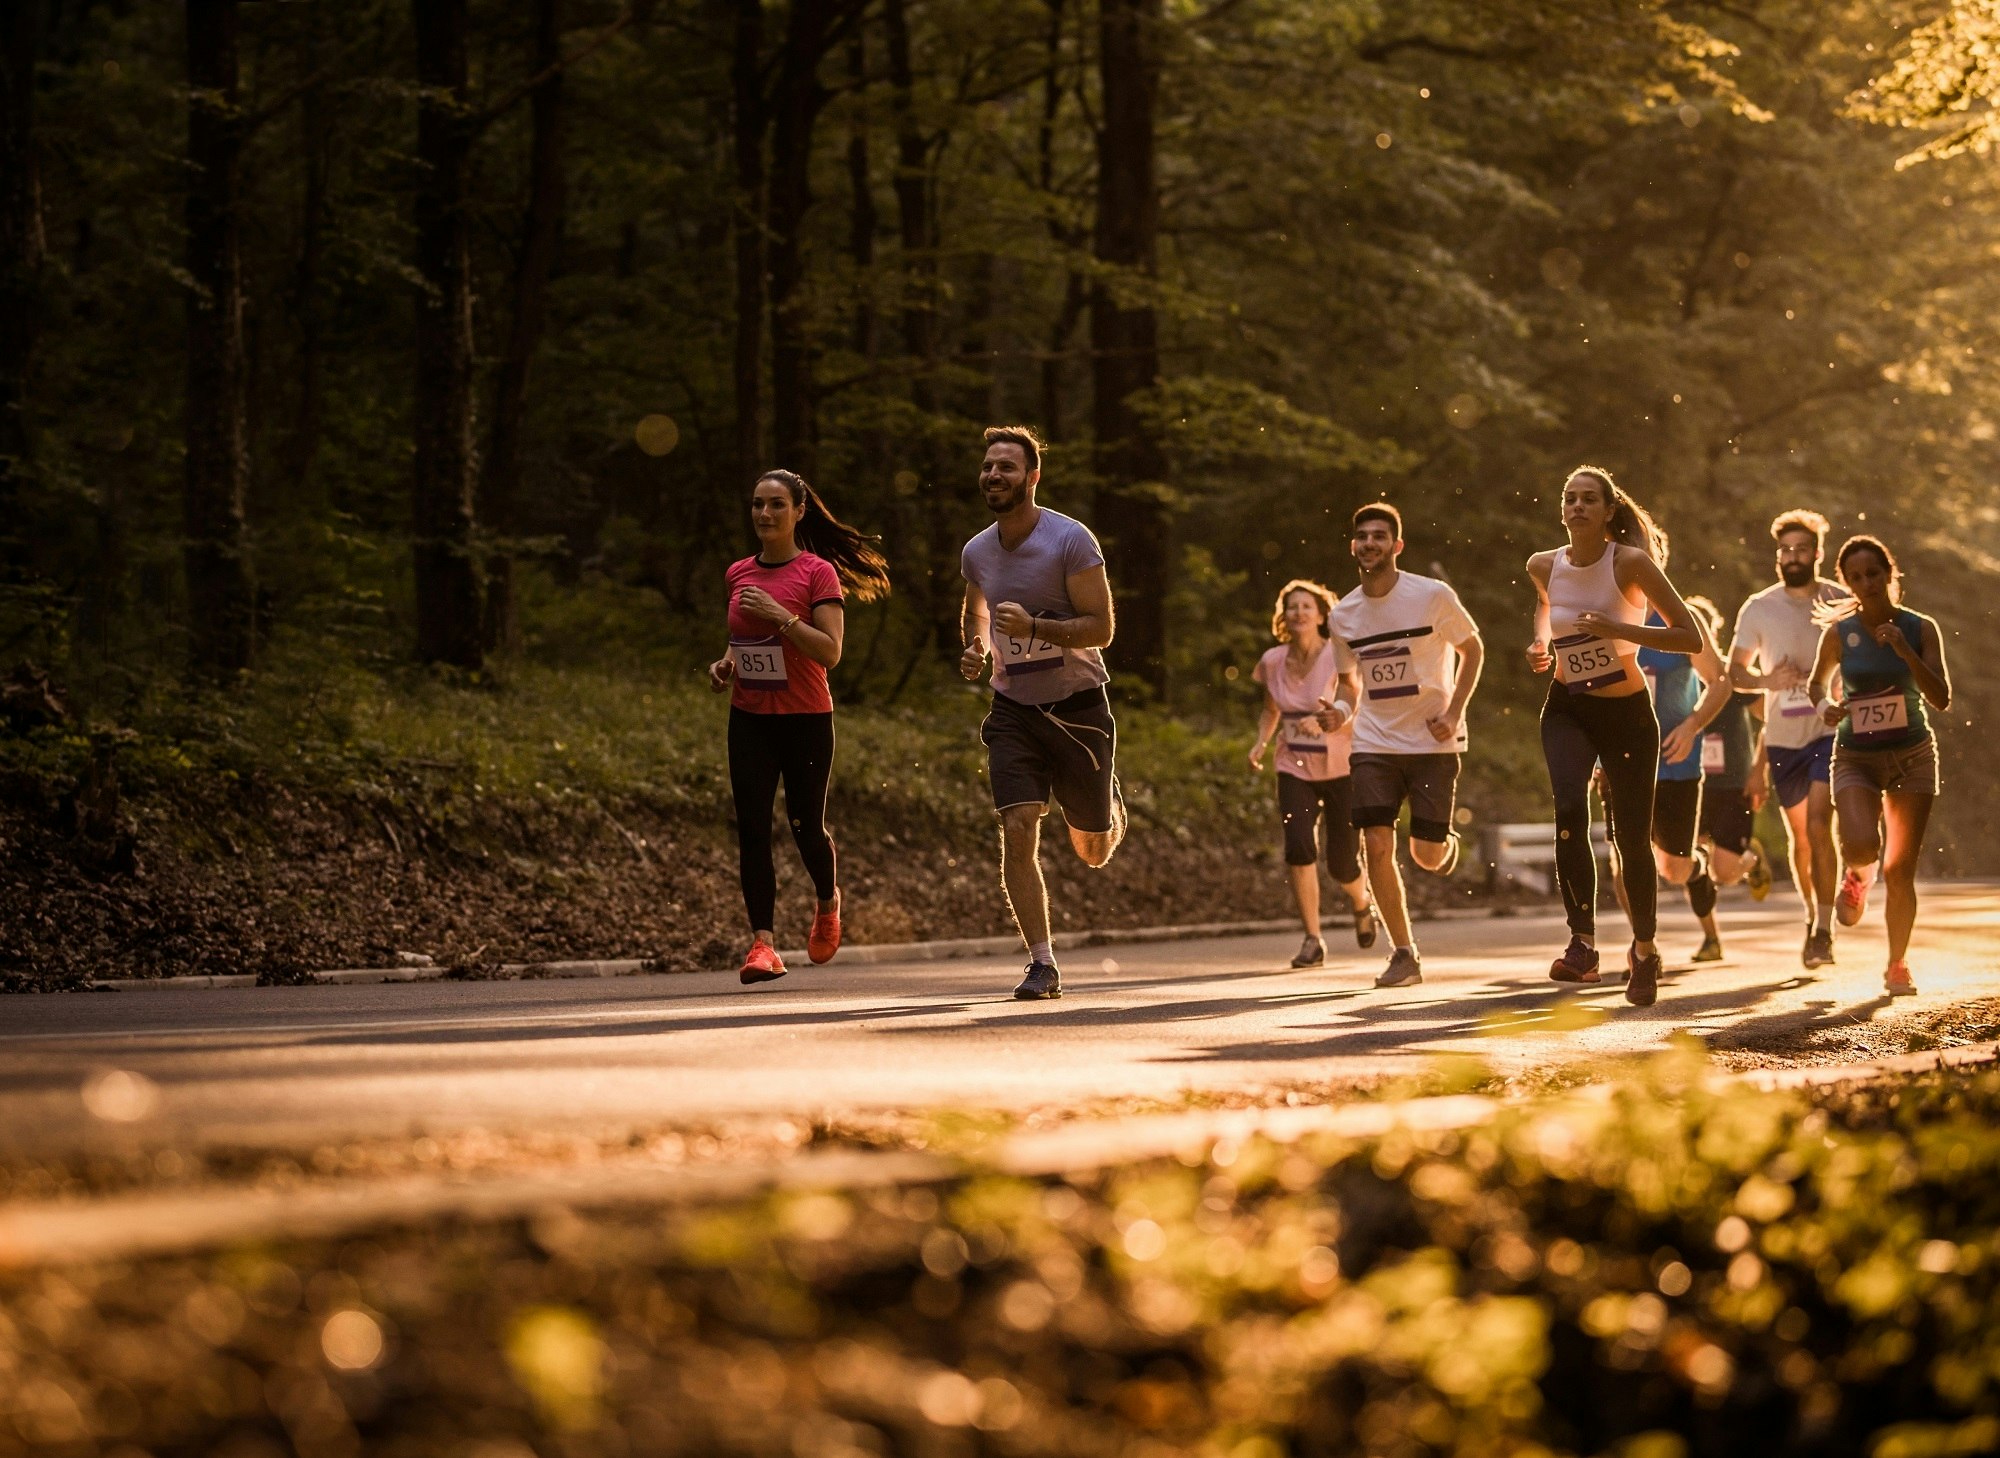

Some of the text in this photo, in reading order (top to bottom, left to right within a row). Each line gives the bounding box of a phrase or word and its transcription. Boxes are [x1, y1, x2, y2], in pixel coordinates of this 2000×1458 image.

[741, 653, 778, 673] 851
[1567, 646, 1611, 674] 855
[1371, 661, 1407, 683] 637
[1858, 702, 1898, 726] 757
